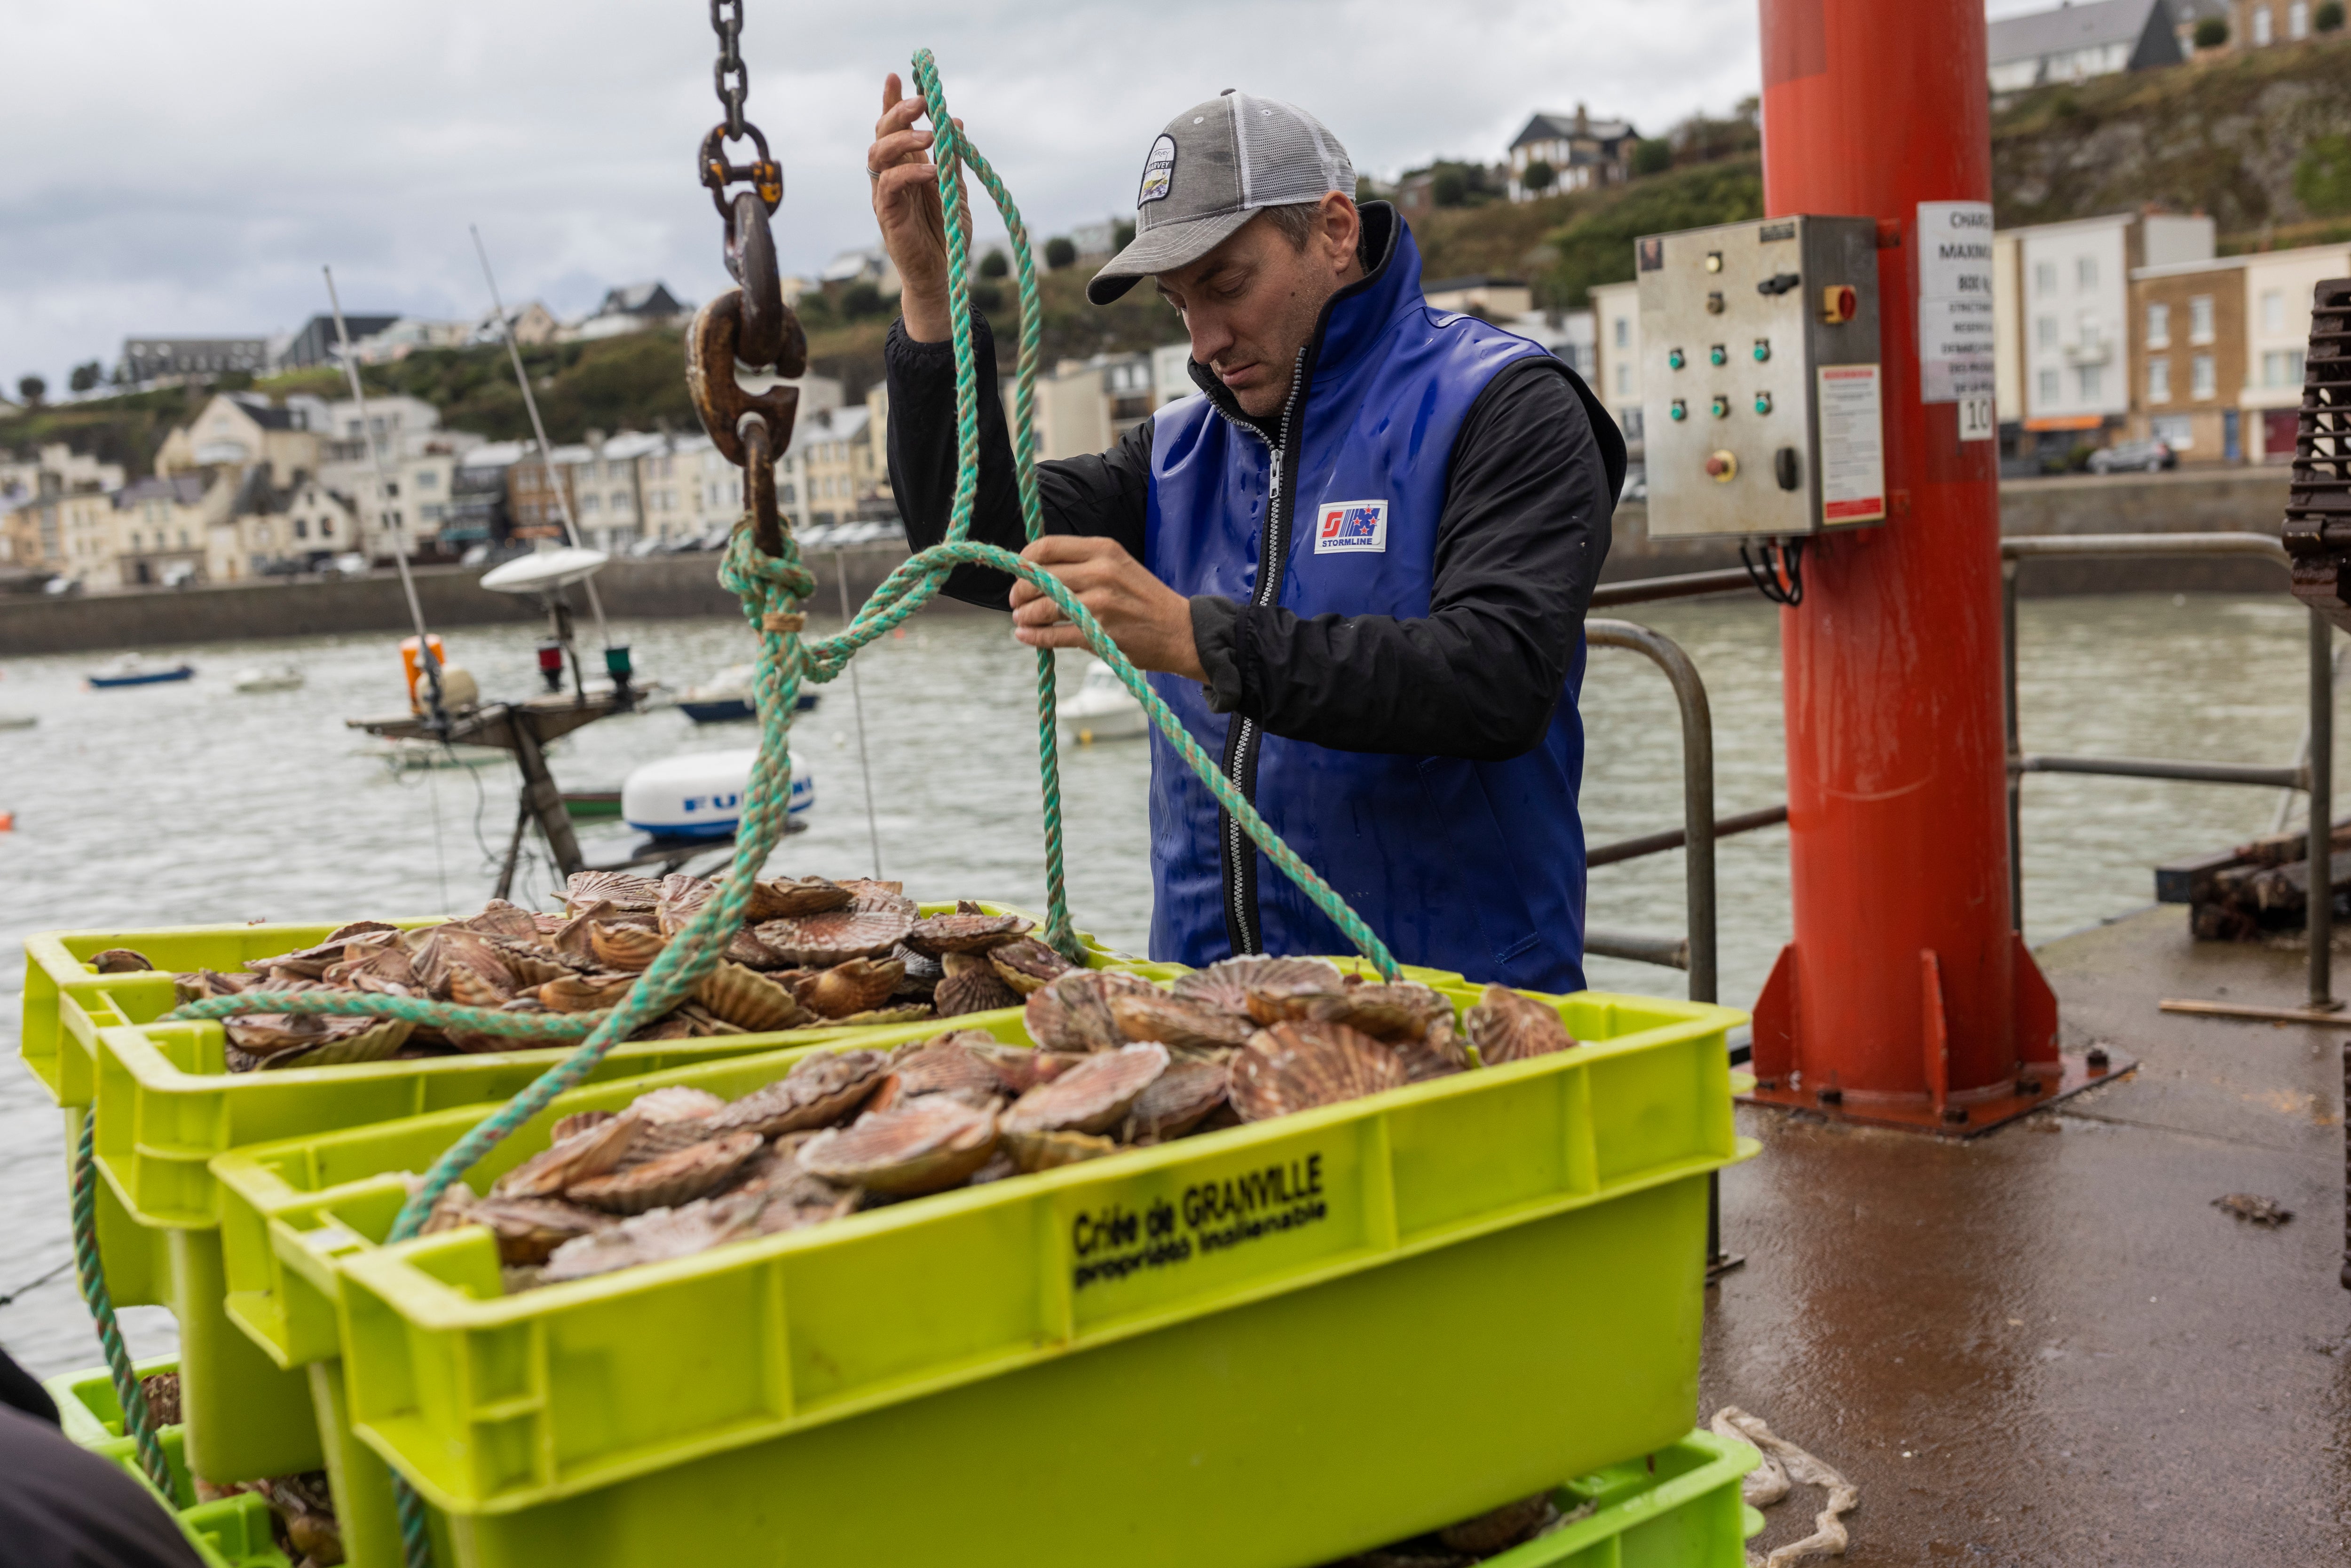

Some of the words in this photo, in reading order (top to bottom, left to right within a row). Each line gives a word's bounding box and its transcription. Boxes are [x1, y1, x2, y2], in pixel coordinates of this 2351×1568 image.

[1967, 400, 1990, 430] 10
[1322, 538, 1373, 547] STORMLINE
[1147, 1197, 1173, 1237] de
[1183, 1152, 1322, 1227] GRANVILLE
